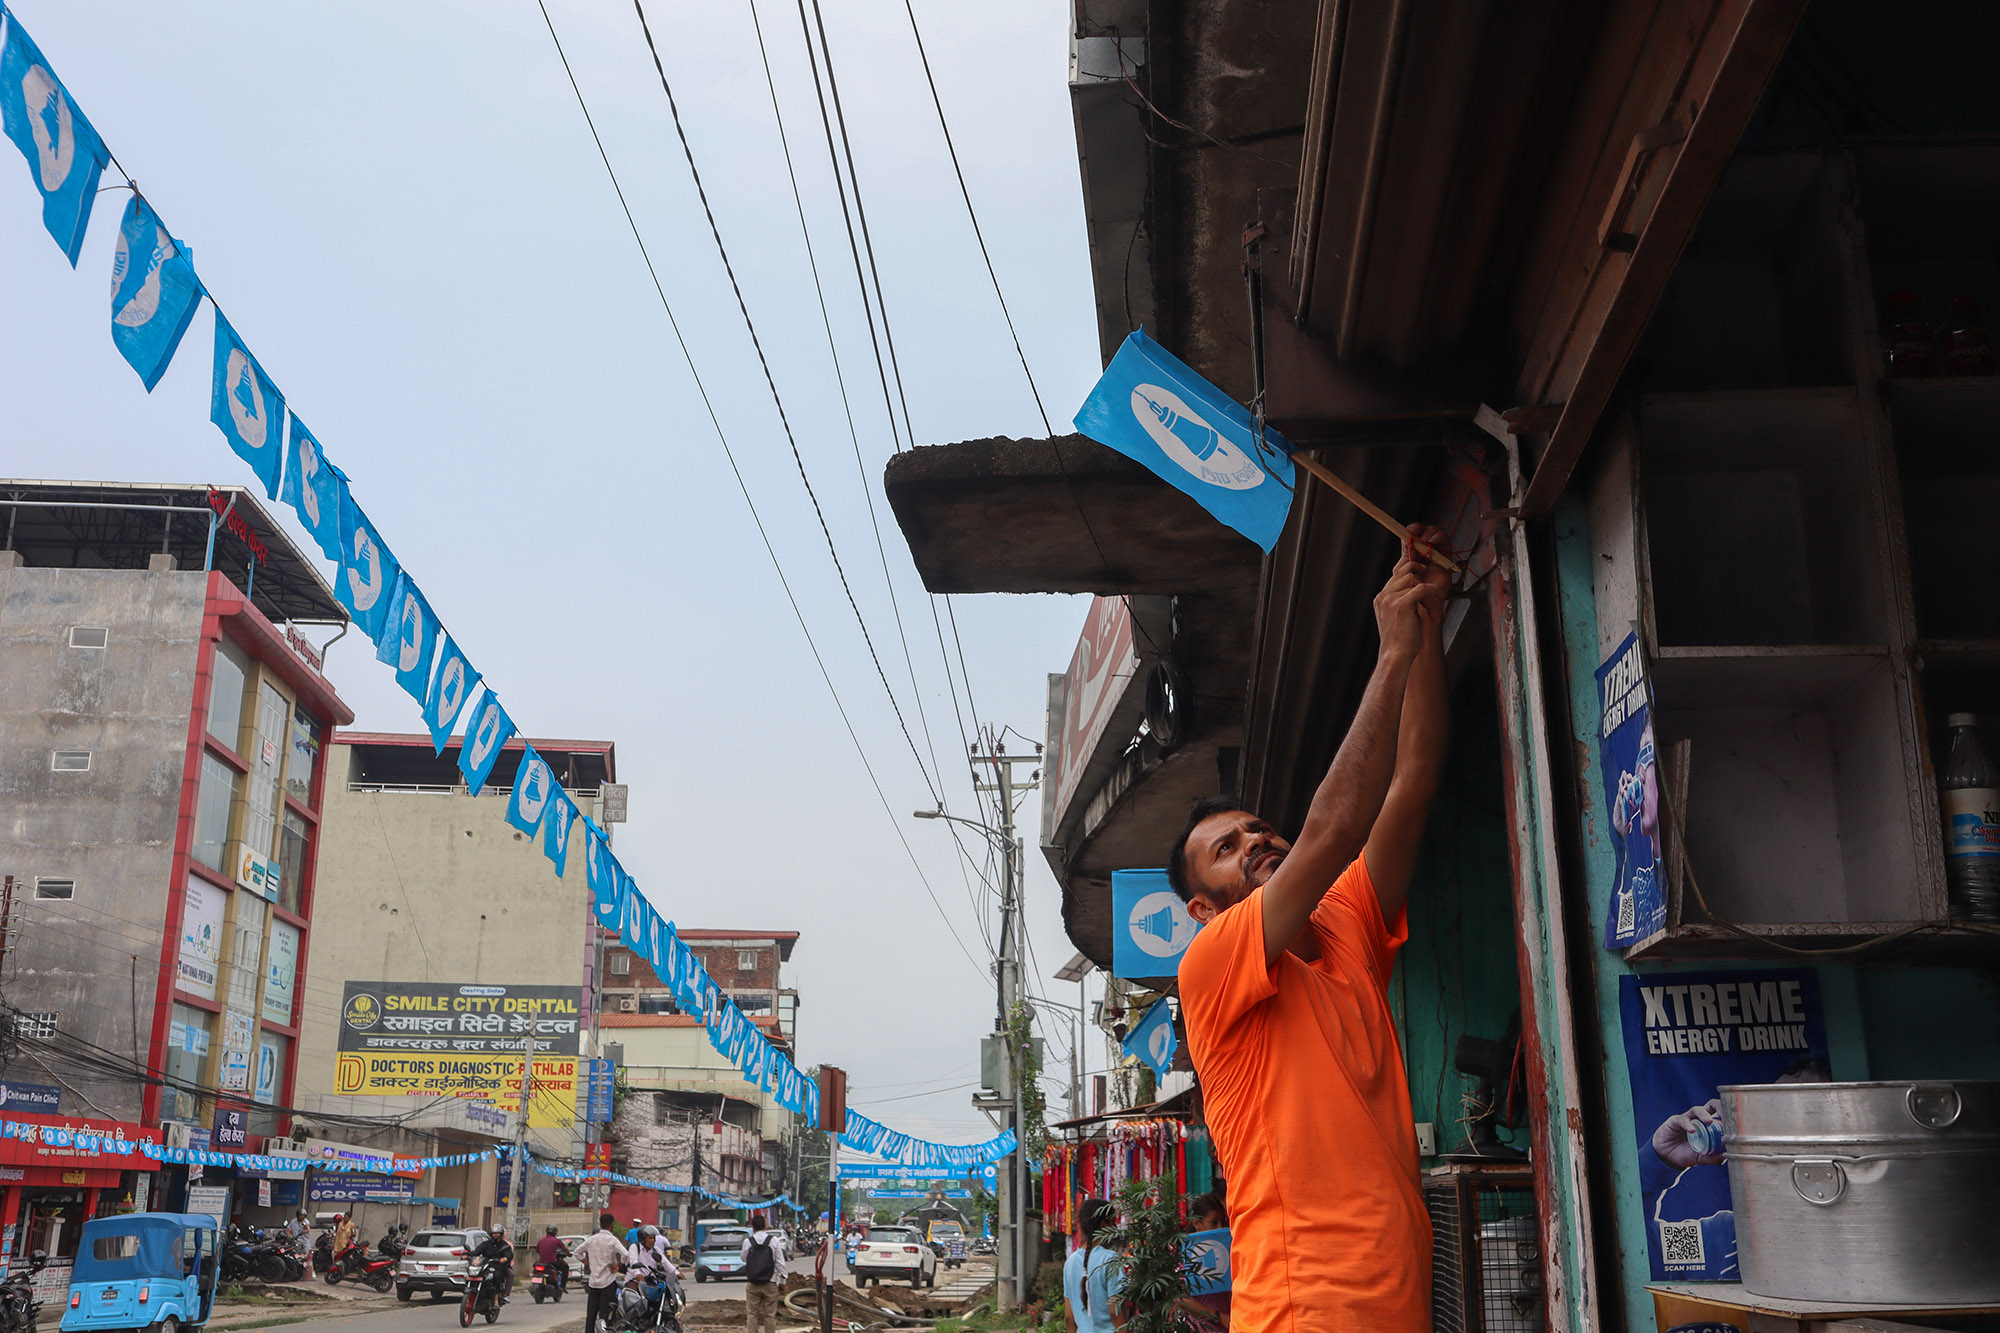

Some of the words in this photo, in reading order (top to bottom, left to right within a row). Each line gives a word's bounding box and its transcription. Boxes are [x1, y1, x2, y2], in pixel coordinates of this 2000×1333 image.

[1604, 638, 1644, 714] XTREM
[1603, 695, 1626, 739] ENERGY
[384, 995, 449, 1011] SMILE
[452, 997, 499, 1012] CITY
[503, 998, 578, 1013] DENTAL
[1640, 980, 1806, 1027] XTREME
[383, 1016, 455, 1034] स्माइल
[459, 1013, 506, 1032] सिटी
[1646, 1027, 1731, 1054] ENERGY
[1738, 1024, 1808, 1051] DRINK
[371, 1059, 434, 1074] DOCTORS
[438, 1061, 515, 1075] DIAGNOSTIC
[518, 1062, 574, 1076] PTHLAB
[369, 1077, 420, 1088] डाक्टर
[7, 1090, 30, 1101] Chitwan
[30, 1092, 42, 1102] Pain
[43, 1093, 59, 1104] Clinic
[1664, 1264, 1683, 1272] SCAN
[1684, 1263, 1706, 1272] HERE
